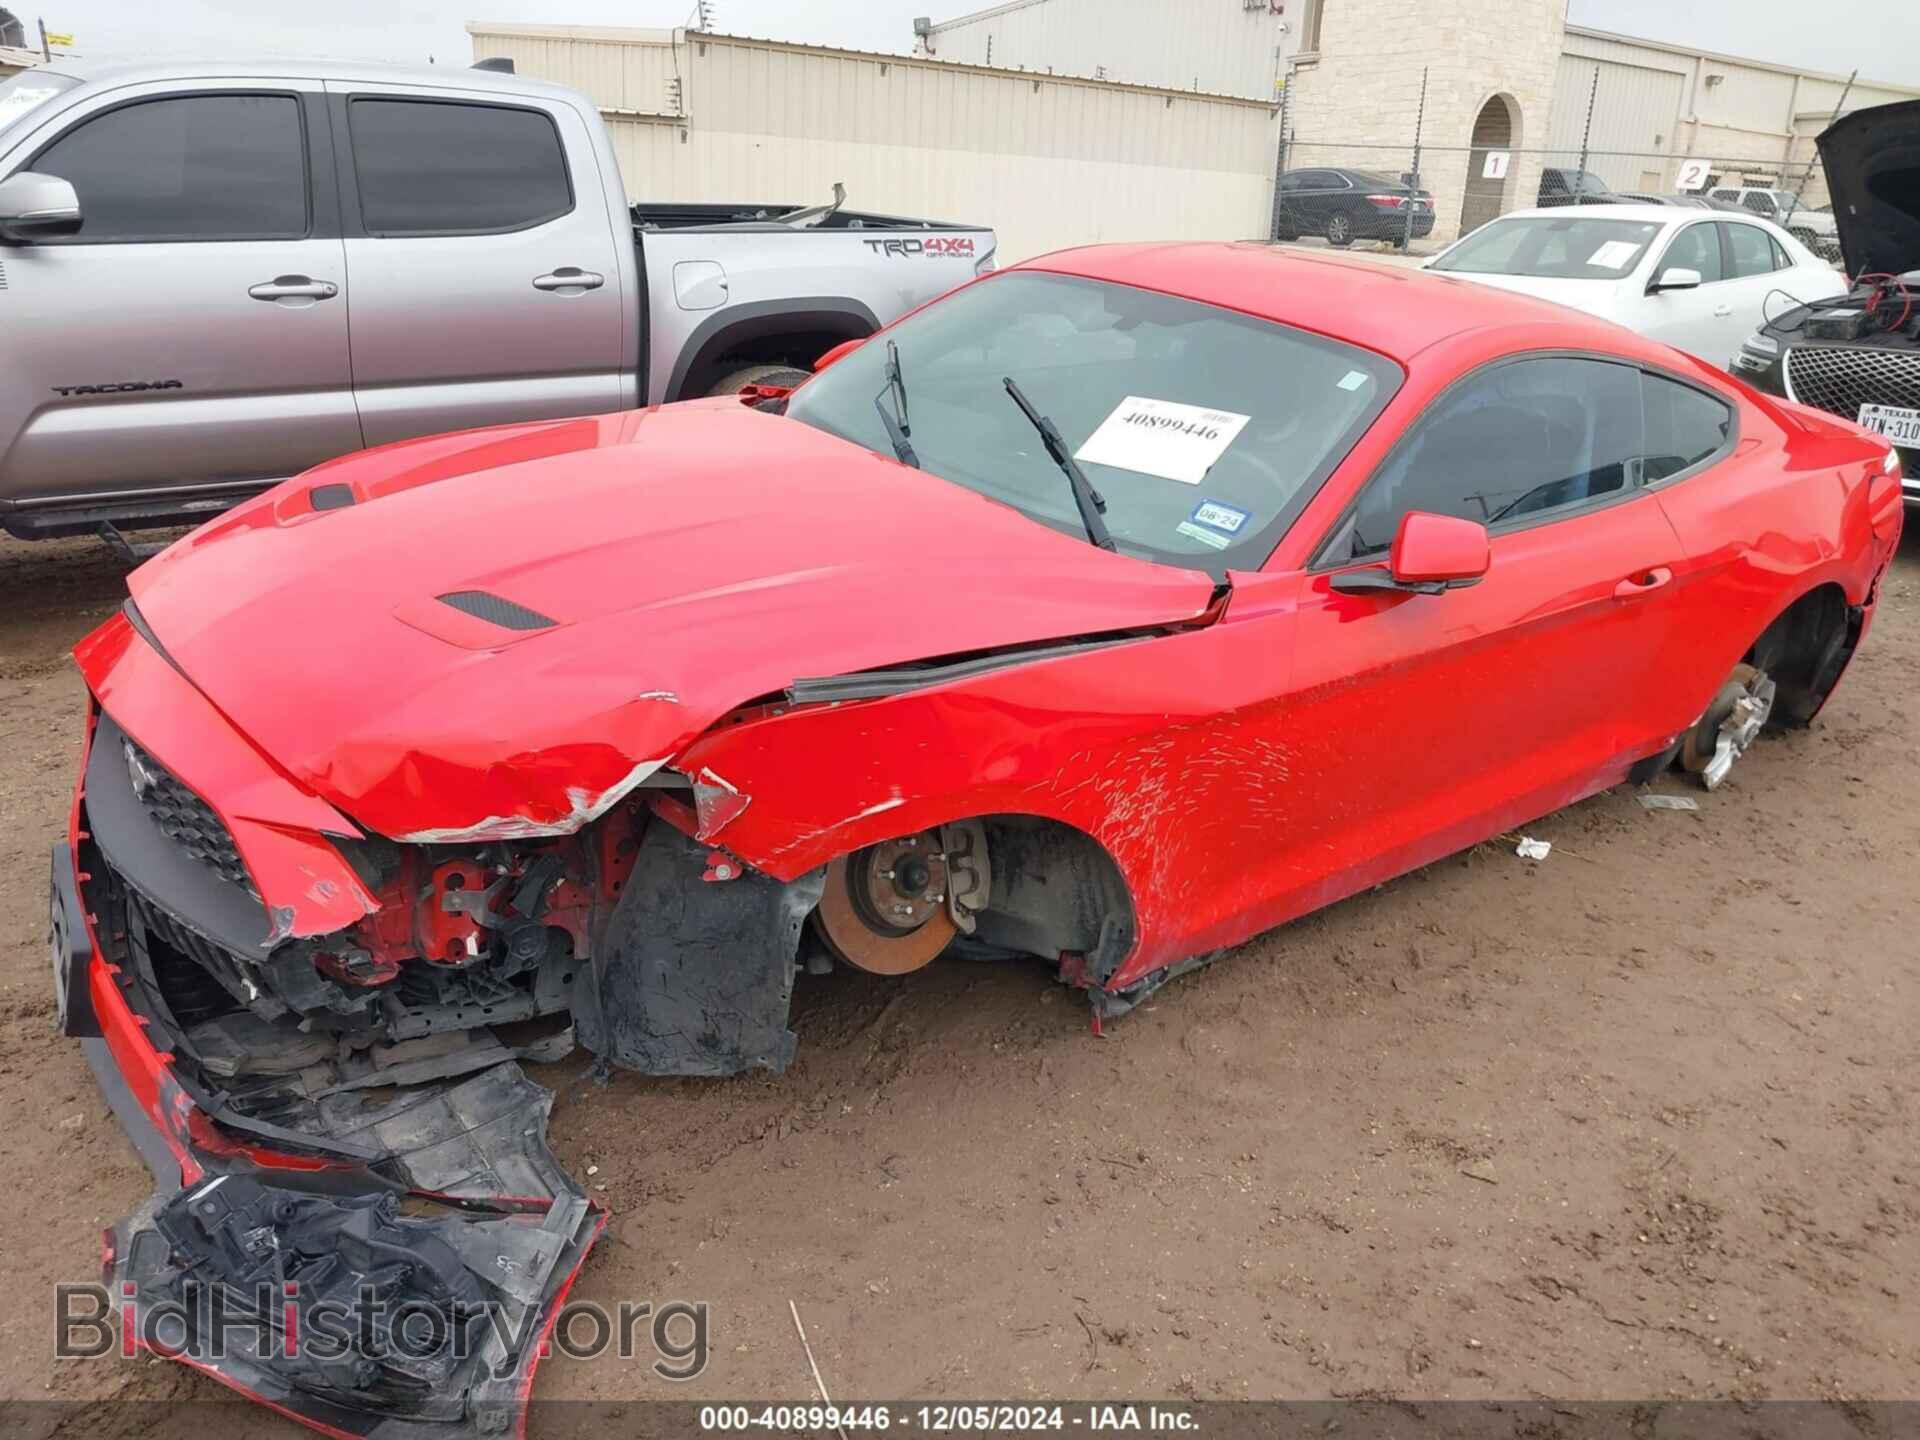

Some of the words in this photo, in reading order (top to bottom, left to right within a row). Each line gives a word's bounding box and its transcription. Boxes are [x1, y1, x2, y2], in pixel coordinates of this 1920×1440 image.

[1491, 157, 1500, 175] 1
[1684, 166, 1700, 184] 2
[51, 379, 183, 397] TACOMA
[1884, 408, 1912, 419] TEXAS
[1123, 412, 1219, 440] 40899446
